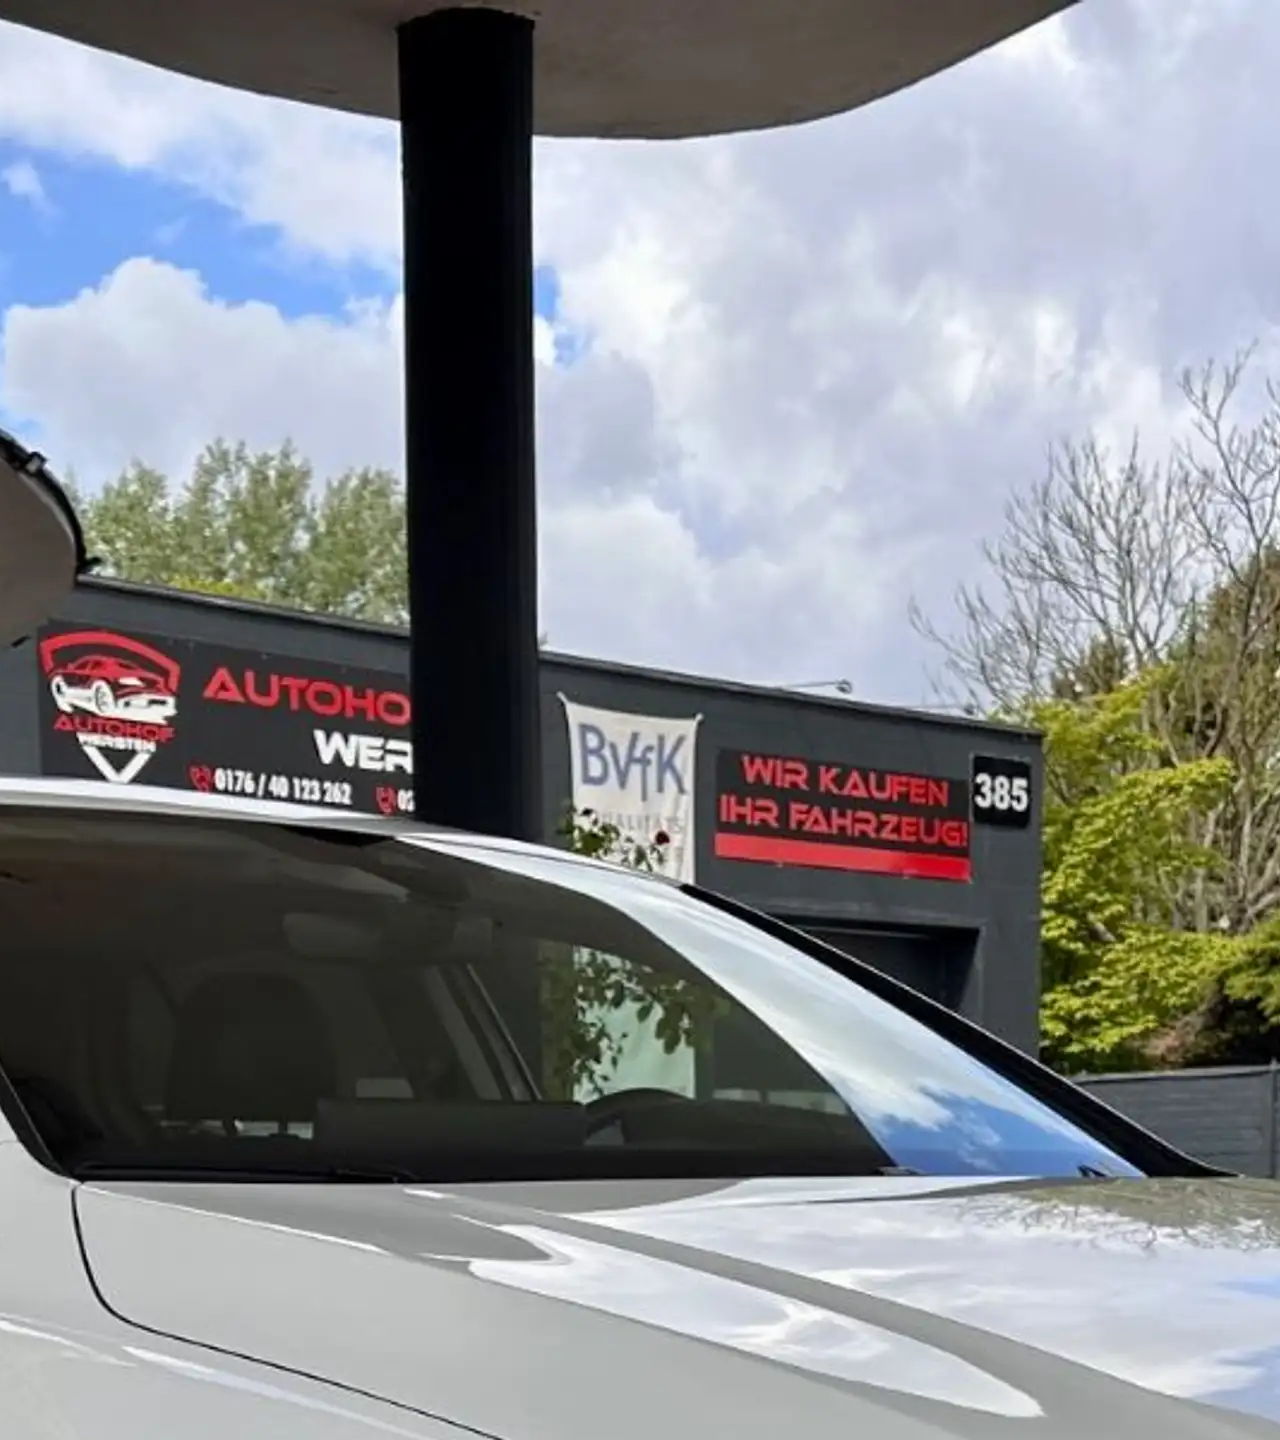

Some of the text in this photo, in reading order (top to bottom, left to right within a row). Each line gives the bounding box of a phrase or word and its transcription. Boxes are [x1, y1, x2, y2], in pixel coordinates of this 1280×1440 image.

[204, 667, 412, 725] AUTOHO
[54, 713, 175, 742] AUTOHOF
[313, 728, 414, 774] WER
[214, 768, 256, 794] 0176
[268, 774, 289, 800] 40
[292, 777, 321, 802] 123
[323, 781, 353, 805] 262
[742, 754, 950, 808] WIR KAUFEN
[973, 772, 1028, 812] 385
[720, 793, 970, 847] IHR FAHRZEUG!
